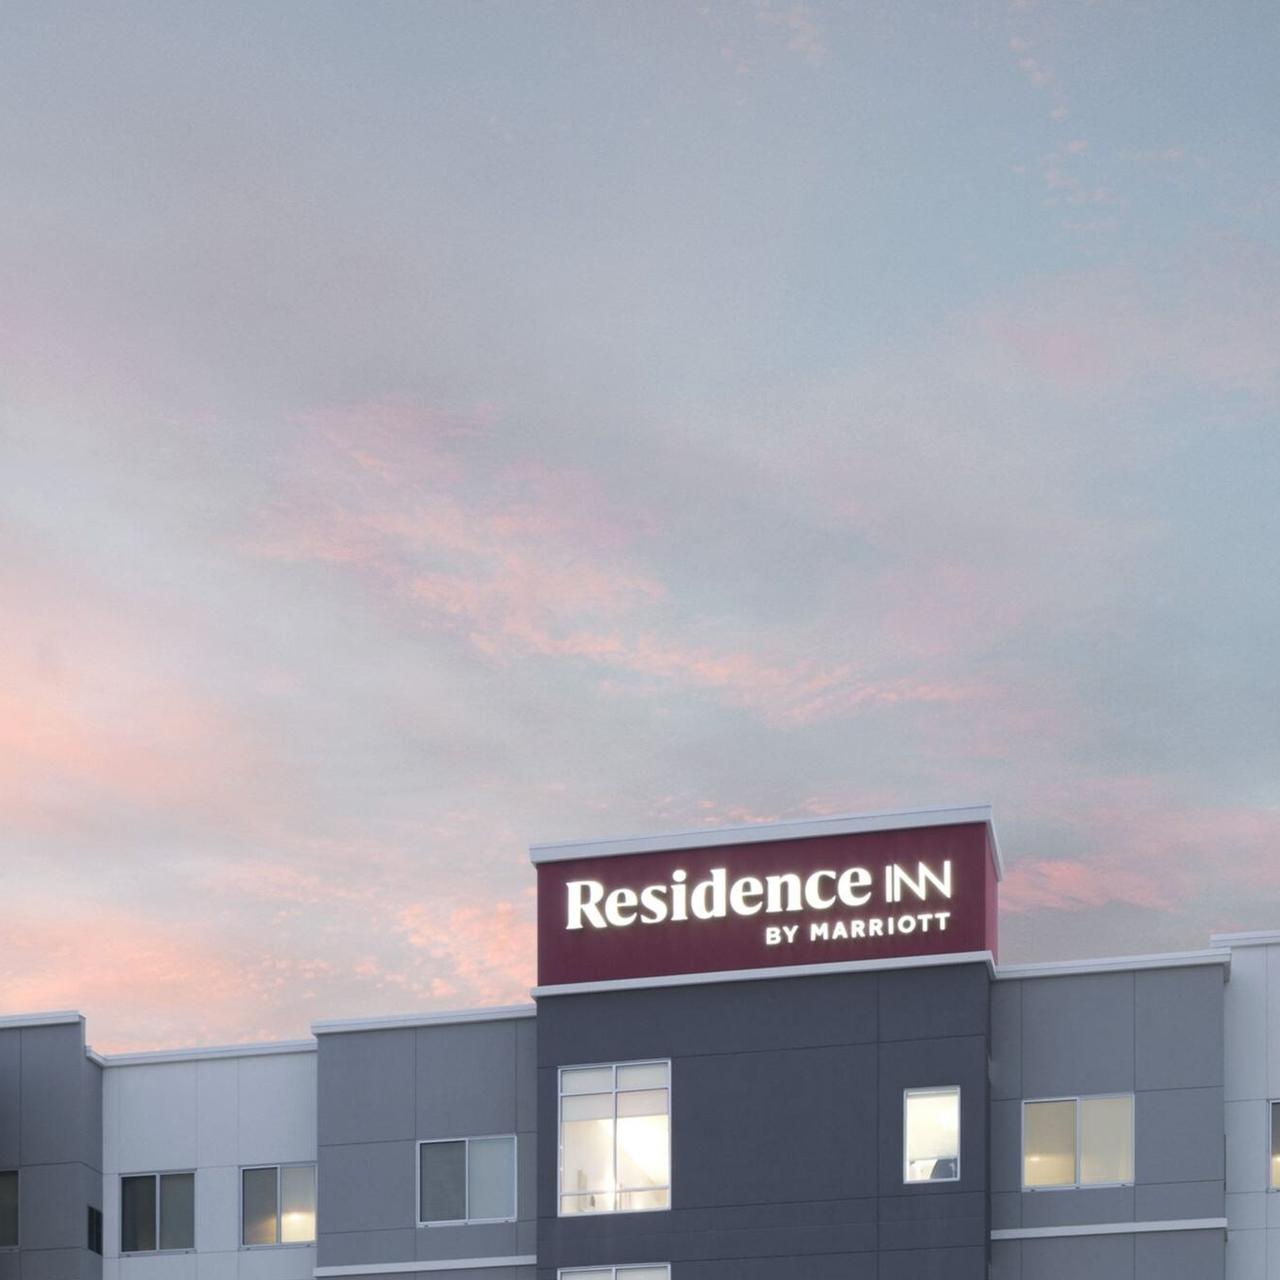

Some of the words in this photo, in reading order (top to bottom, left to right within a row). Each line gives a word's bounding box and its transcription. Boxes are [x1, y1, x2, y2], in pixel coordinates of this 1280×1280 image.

[565, 867, 872, 930] Residence
[885, 860, 952, 903] INN
[765, 925, 799, 945] BY
[810, 911, 951, 941] MARRIOTT
